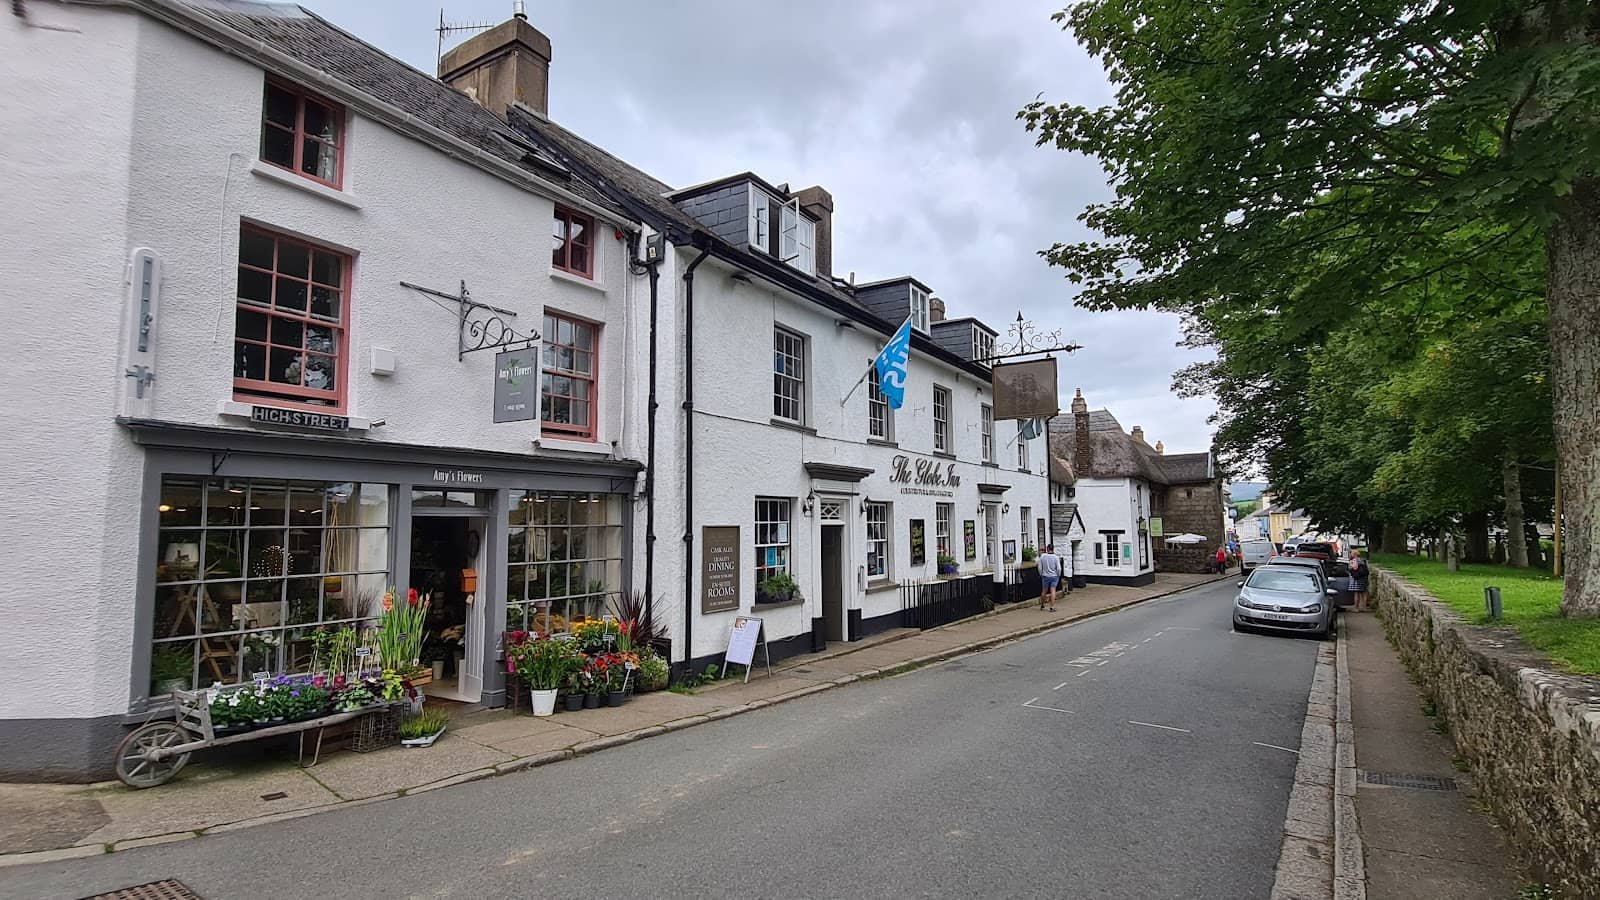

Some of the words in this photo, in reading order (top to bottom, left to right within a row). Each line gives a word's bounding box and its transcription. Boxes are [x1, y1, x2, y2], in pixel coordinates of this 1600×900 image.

[254, 407, 289, 423] HIGH
[292, 412, 347, 429] STREET
[433, 469, 455, 484] Amy's
[457, 470, 482, 483] Flowers
[889, 455, 913, 484] The
[914, 458, 942, 487] Globe
[941, 463, 961, 488] Inn
[708, 561, 735, 572] DINING
[707, 586, 735, 598] ROOMS
